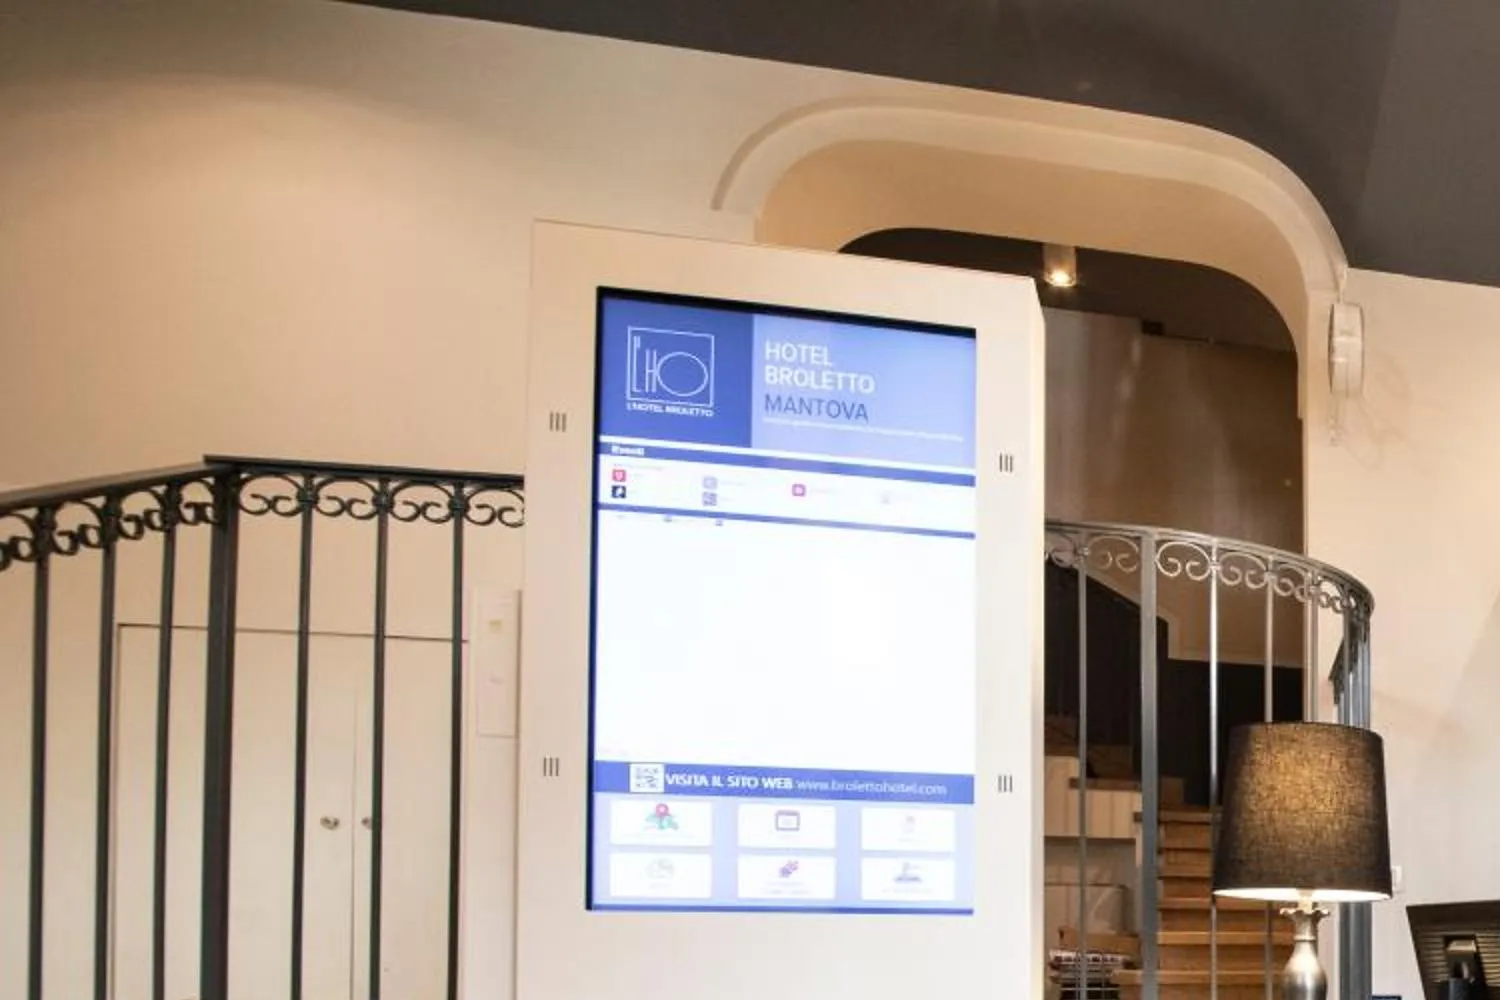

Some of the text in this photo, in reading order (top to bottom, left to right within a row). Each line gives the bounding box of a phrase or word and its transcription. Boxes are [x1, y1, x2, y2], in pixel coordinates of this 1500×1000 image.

[765, 340, 834, 367] HOTEL
[765, 365, 876, 394] BROLETTO
[764, 394, 869, 422] MANTOVA
[665, 773, 709, 787] VISITA
[711, 775, 724, 788] IL
[726, 775, 759, 789] SITO
[761, 777, 793, 790] WEB
